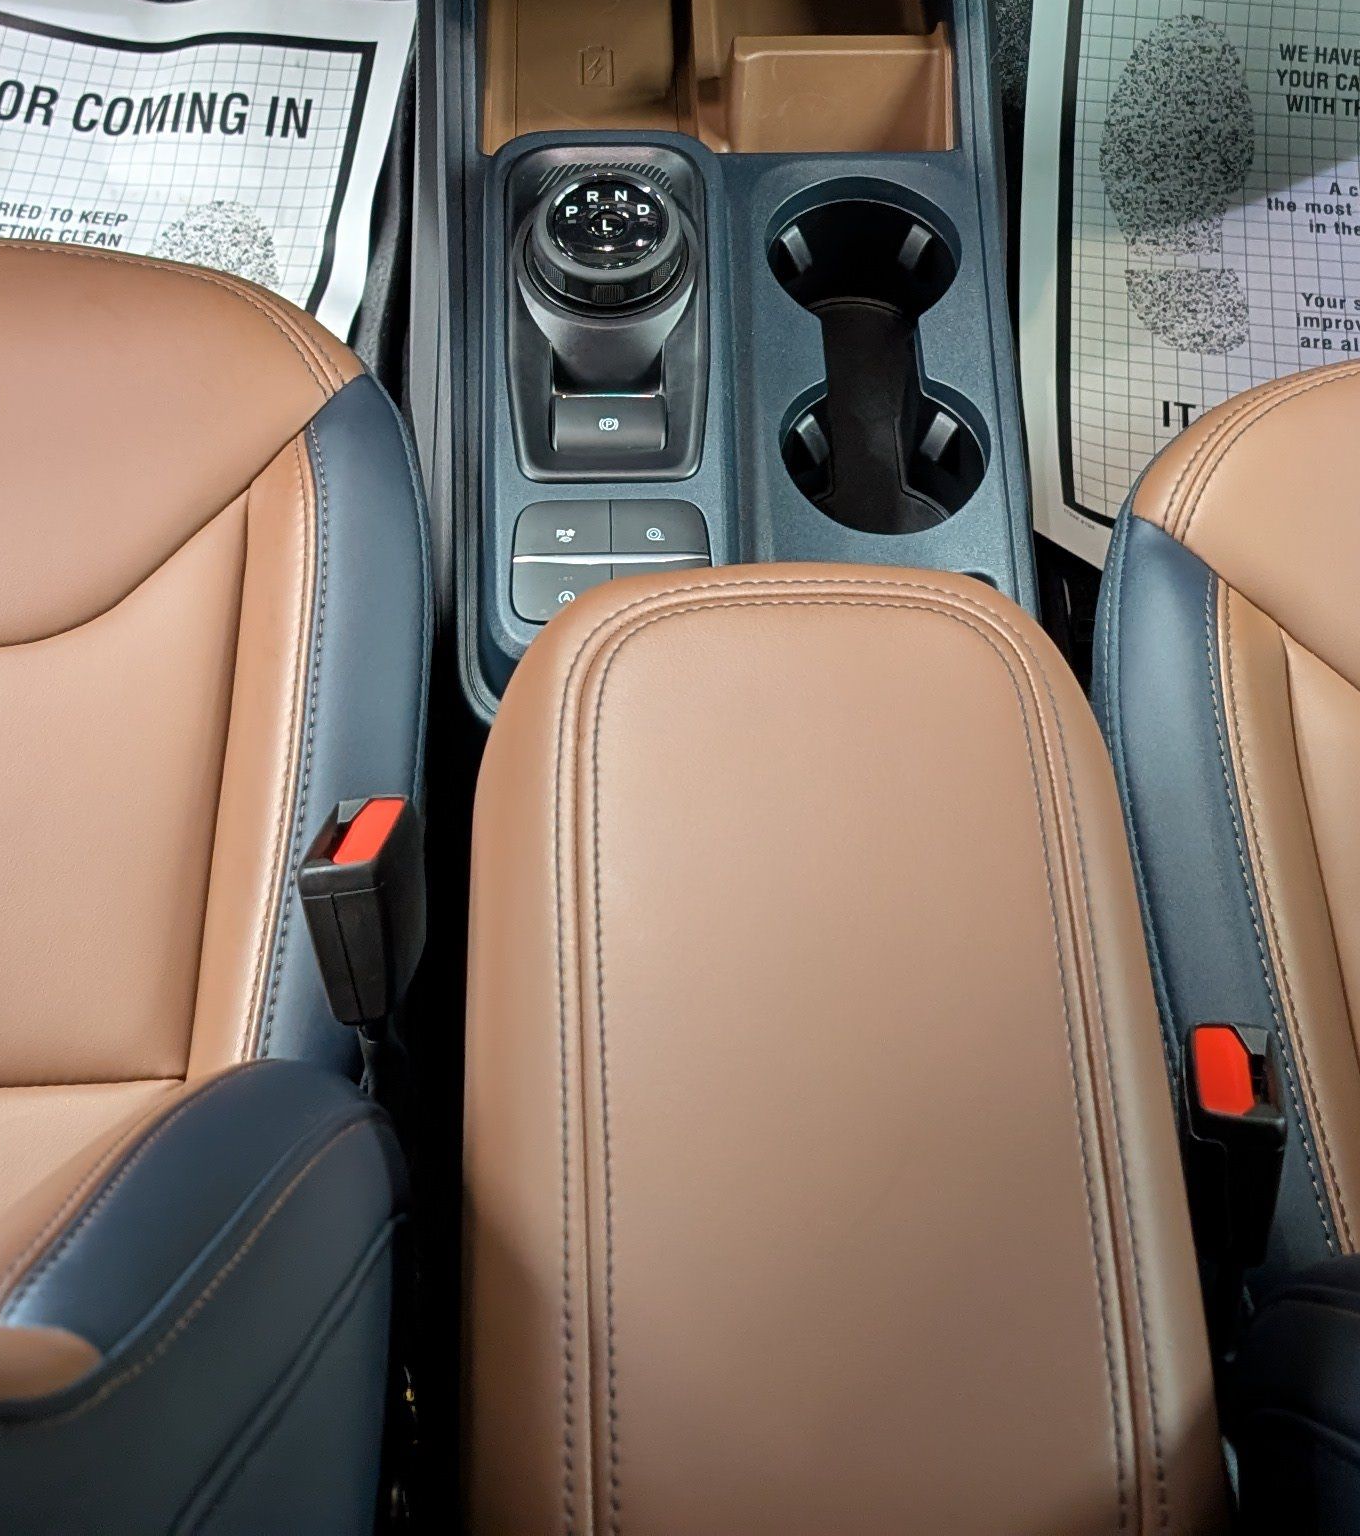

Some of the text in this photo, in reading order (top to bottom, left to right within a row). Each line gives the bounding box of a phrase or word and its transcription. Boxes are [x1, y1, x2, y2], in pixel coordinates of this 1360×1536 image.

[1278, 43, 1309, 63] WE
[1276, 69, 1329, 90] YOUR
[1285, 95, 1336, 115] WITH
[72, 91, 250, 136] COMING
[265, 95, 313, 139] IN
[586, 191, 599, 203] R
[614, 190, 628, 202] N
[1329, 182, 1342, 196] A
[565, 205, 579, 218] P
[636, 204, 650, 216] D
[1266, 197, 1297, 212] the
[1305, 202, 1352, 216] most
[49, 207, 73, 224] TO
[78, 210, 129, 228] KEEP
[602, 219, 613, 231] L
[1309, 219, 1327, 233] in
[58, 229, 123, 248] CLEAN
[1301, 292, 1346, 310] Your
[1300, 336, 1333, 351] are
[1162, 400, 1197, 429] IT
